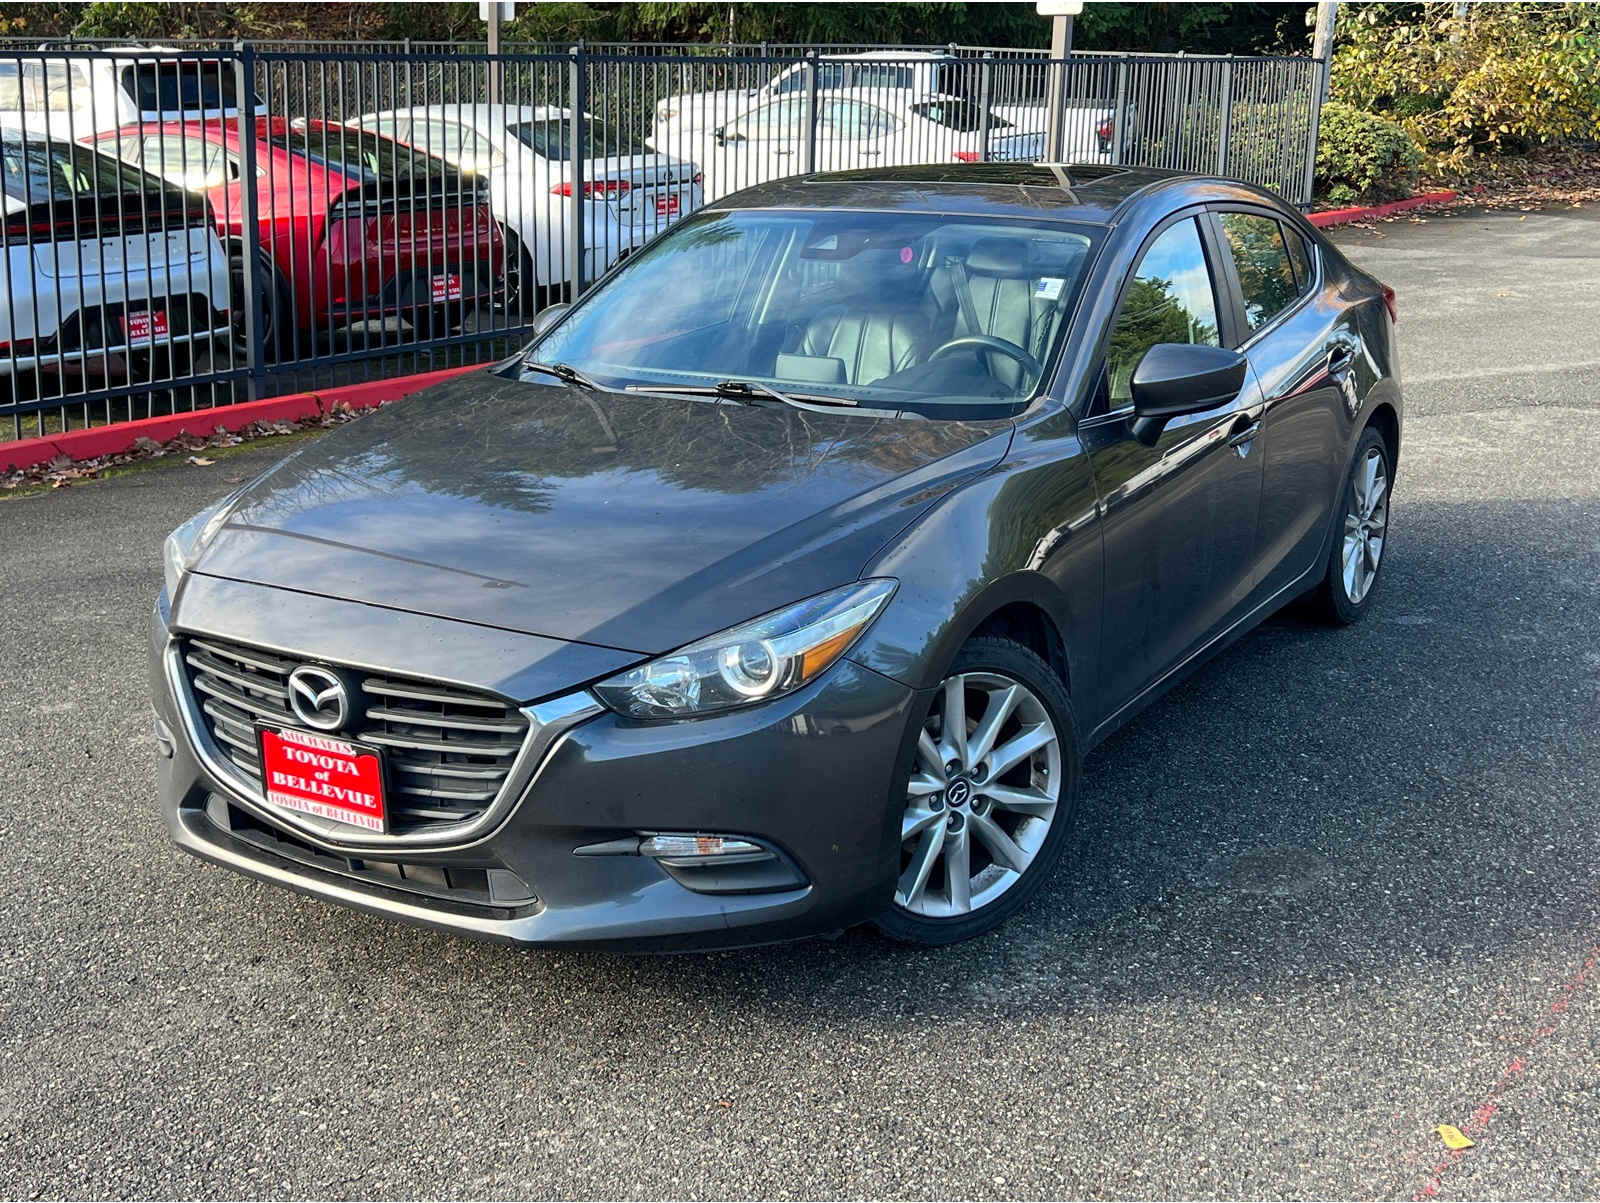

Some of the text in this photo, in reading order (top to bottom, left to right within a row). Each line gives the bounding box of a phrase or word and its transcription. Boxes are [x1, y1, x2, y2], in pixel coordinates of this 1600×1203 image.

[282, 745, 360, 776] TOYOTA
[314, 771, 330, 782] of
[270, 793, 310, 810] TOYOTA
[272, 771, 377, 809] BELLEVUE
